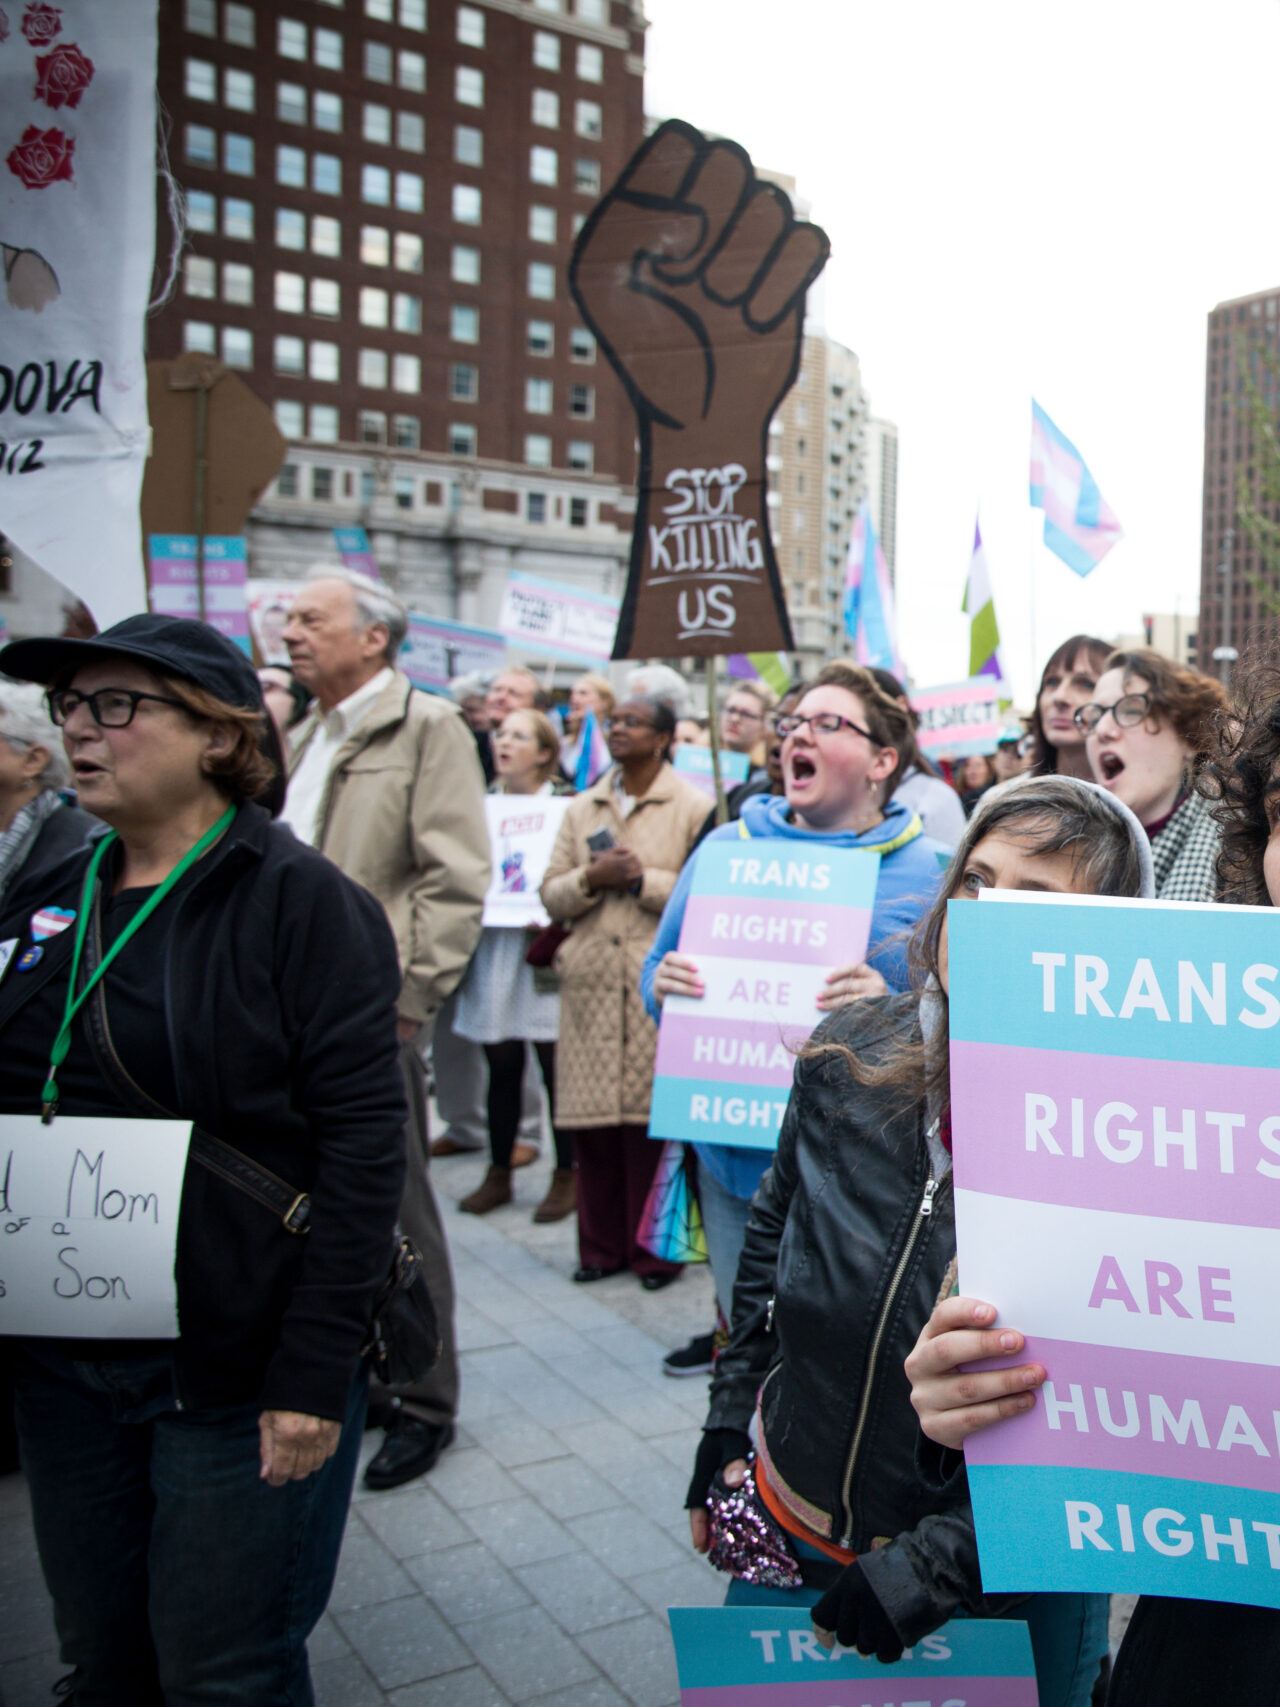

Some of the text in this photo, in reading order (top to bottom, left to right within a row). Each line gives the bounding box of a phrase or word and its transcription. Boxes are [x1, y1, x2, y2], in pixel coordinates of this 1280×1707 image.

[662, 463, 747, 517] STOP
[169, 540, 226, 556] TRNS
[649, 519, 764, 573] KILLING
[678, 585, 736, 630] US
[729, 858, 831, 890] TRANS
[711, 913, 829, 948] RIGHTS
[729, 979, 791, 1006] ARE
[693, 1035, 793, 1071] HUMA
[689, 1094, 787, 1128] RIGHT
[67, 1149, 158, 1224] Mom
[52, 1222, 71, 1236] a
[54, 1247, 131, 1300] Son
[1088, 1255, 1236, 1324] ARE
[750, 1629, 953, 1664] TRS
